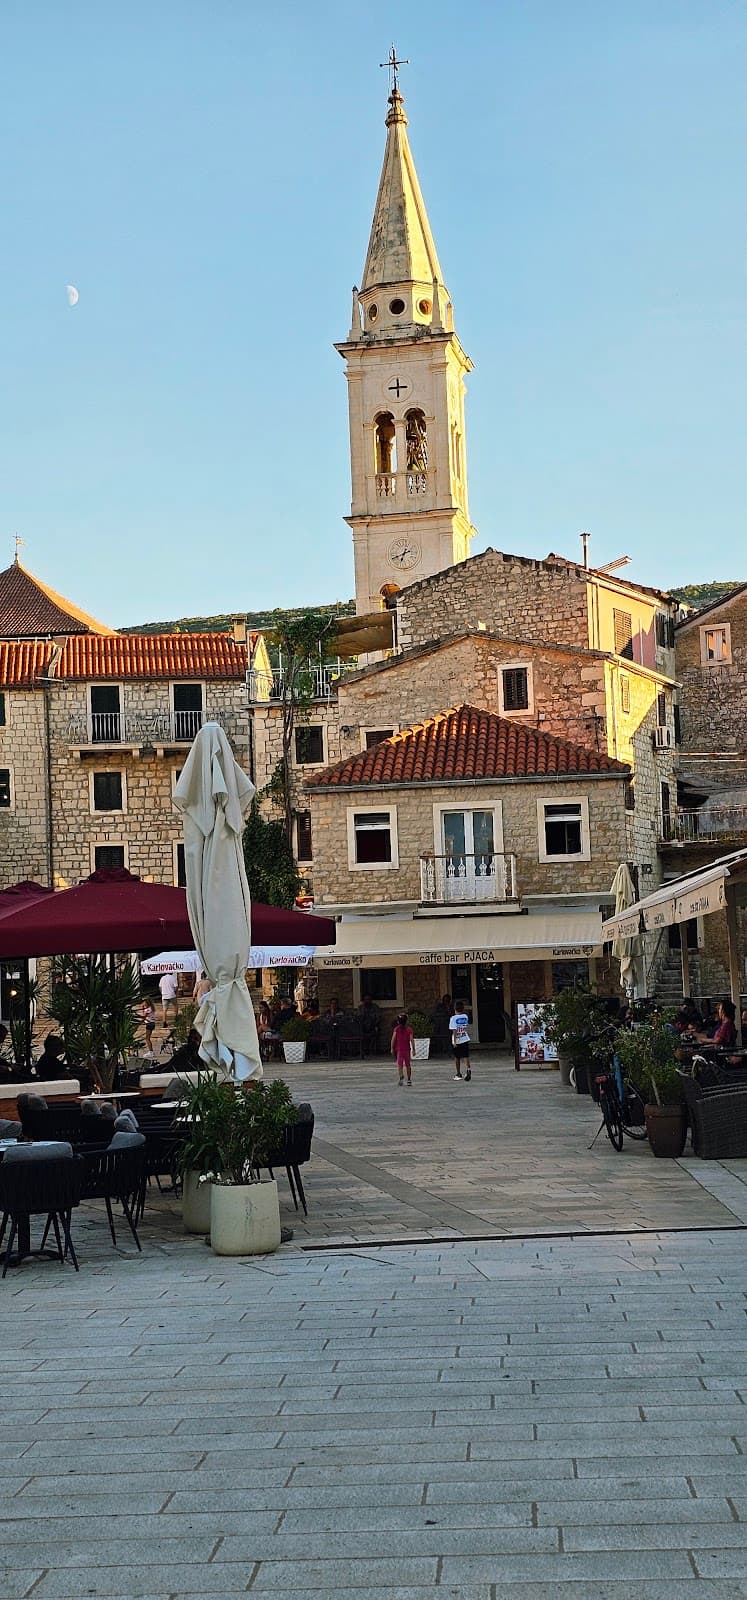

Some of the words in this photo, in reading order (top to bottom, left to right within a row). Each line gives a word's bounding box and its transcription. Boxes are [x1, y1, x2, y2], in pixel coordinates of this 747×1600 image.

[419, 953, 442, 964] caffe
[444, 952, 459, 963] bar
[464, 951, 495, 962] PJACA
